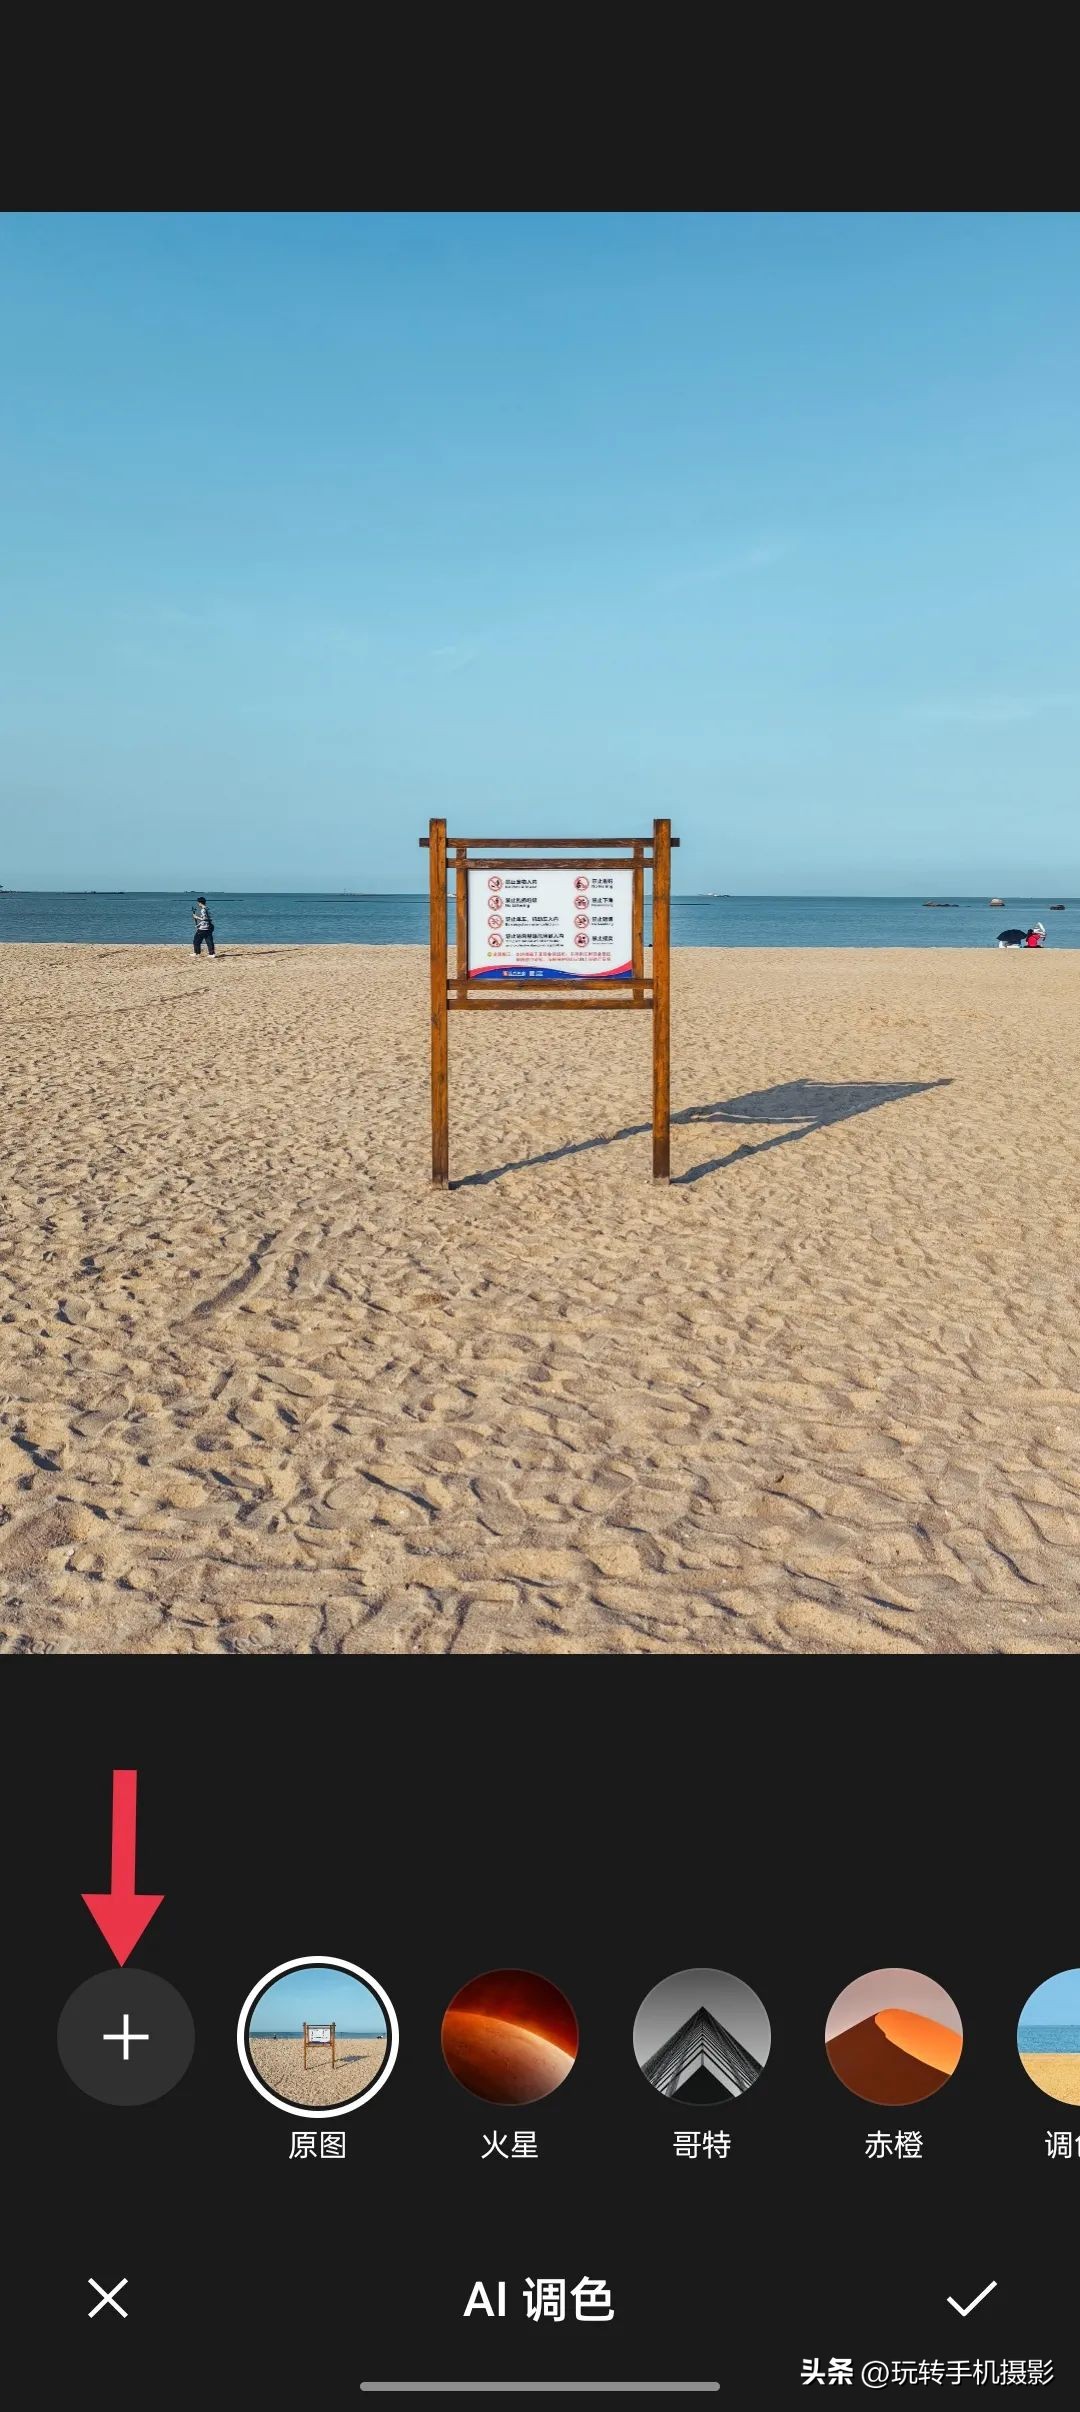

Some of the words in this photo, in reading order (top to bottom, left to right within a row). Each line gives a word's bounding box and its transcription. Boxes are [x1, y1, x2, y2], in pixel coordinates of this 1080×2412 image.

[288, 2131, 346, 2160] 原图
[480, 2130, 539, 2160] 火星
[672, 2130, 732, 2160] 哥特
[864, 2130, 924, 2160] 赤橙
[1044, 2130, 1080, 2160] 调
[462, 2280, 506, 2317] AI
[522, 2275, 615, 2323] 调色
